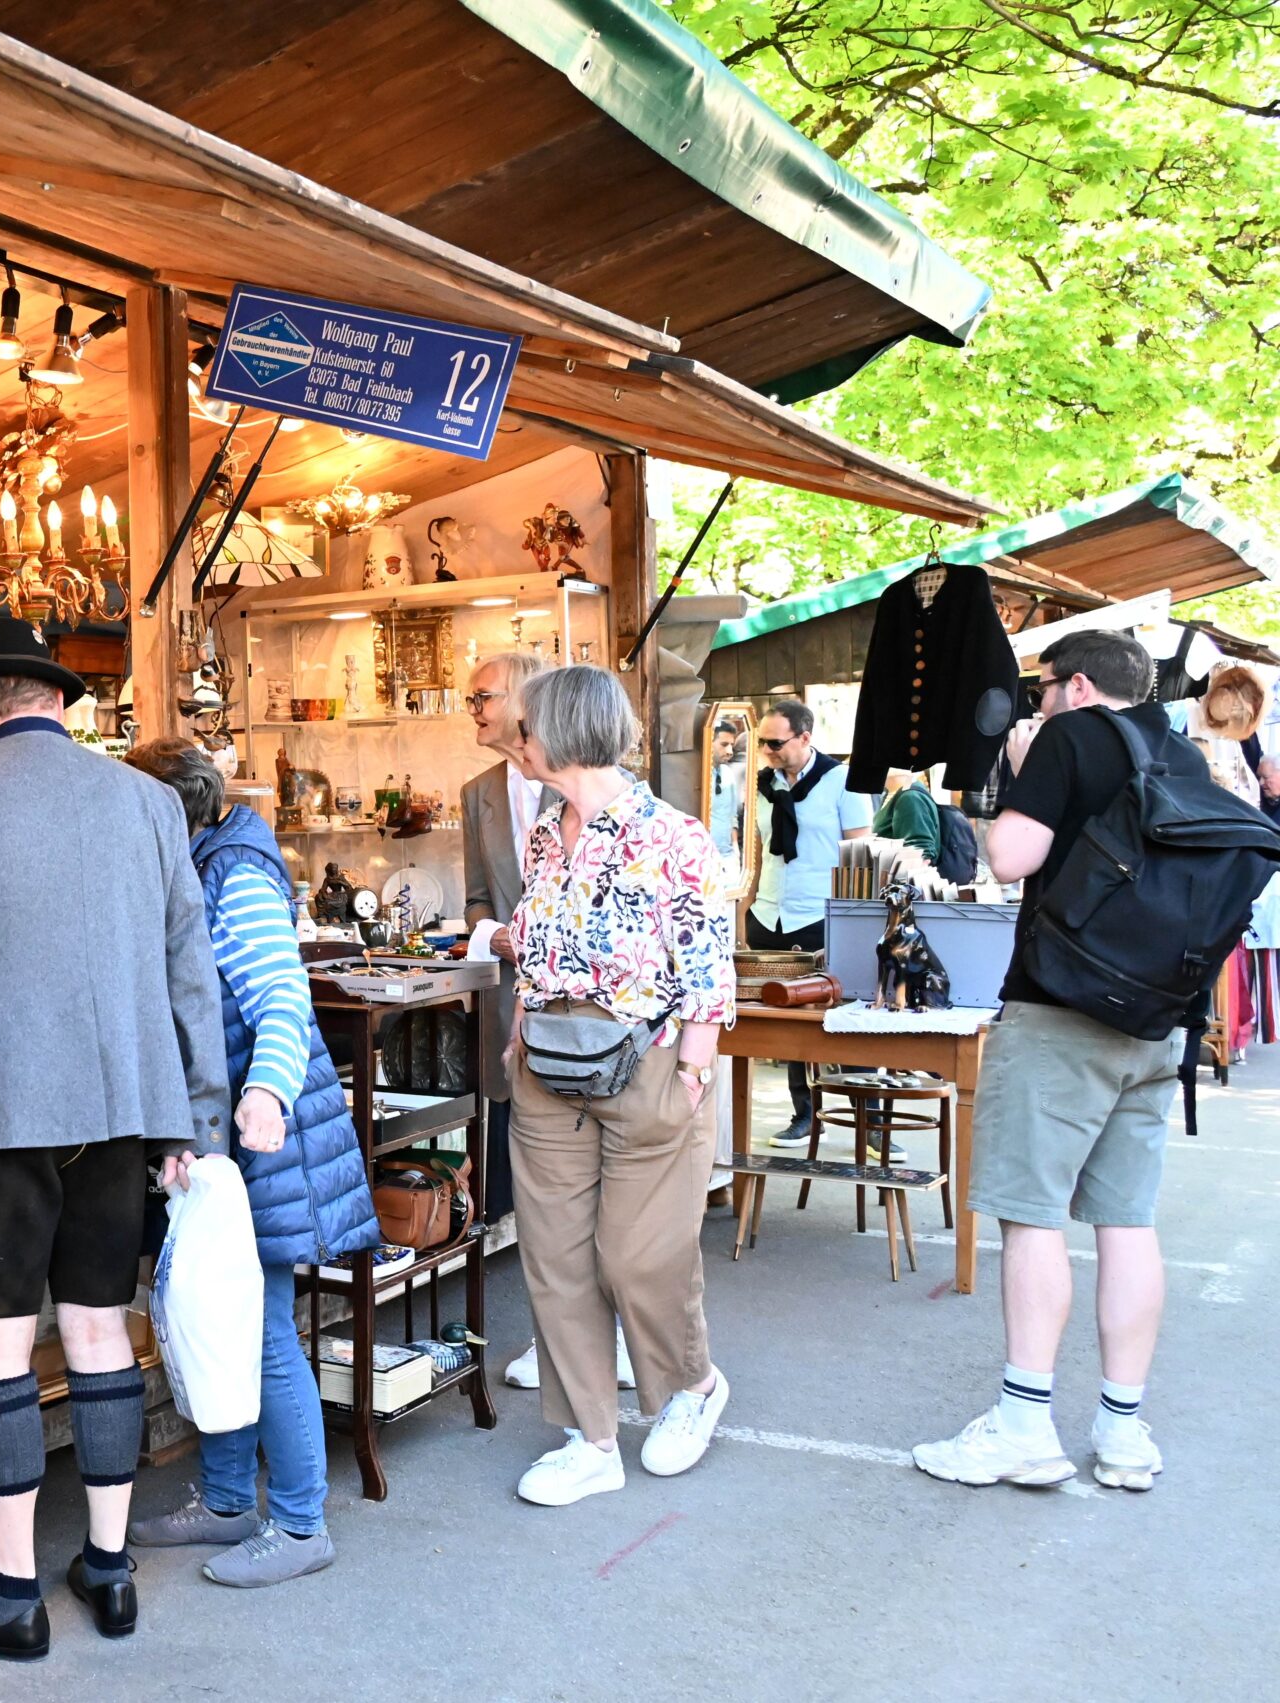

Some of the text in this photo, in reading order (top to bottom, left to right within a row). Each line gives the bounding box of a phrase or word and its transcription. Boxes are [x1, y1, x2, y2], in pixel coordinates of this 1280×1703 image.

[231, 336, 311, 360] Gebrauchtwarenhändler
[321, 319, 415, 357] Wolfgang Paul
[252, 358, 280, 370] in Bayern
[313, 346, 395, 378] Kufsteinerstr. 60
[303, 386, 318, 404] Tel.
[307, 366, 414, 405] 83075 Bad Feilnbach
[440, 350, 491, 413] 12
[442, 423, 462, 437] Gasse
